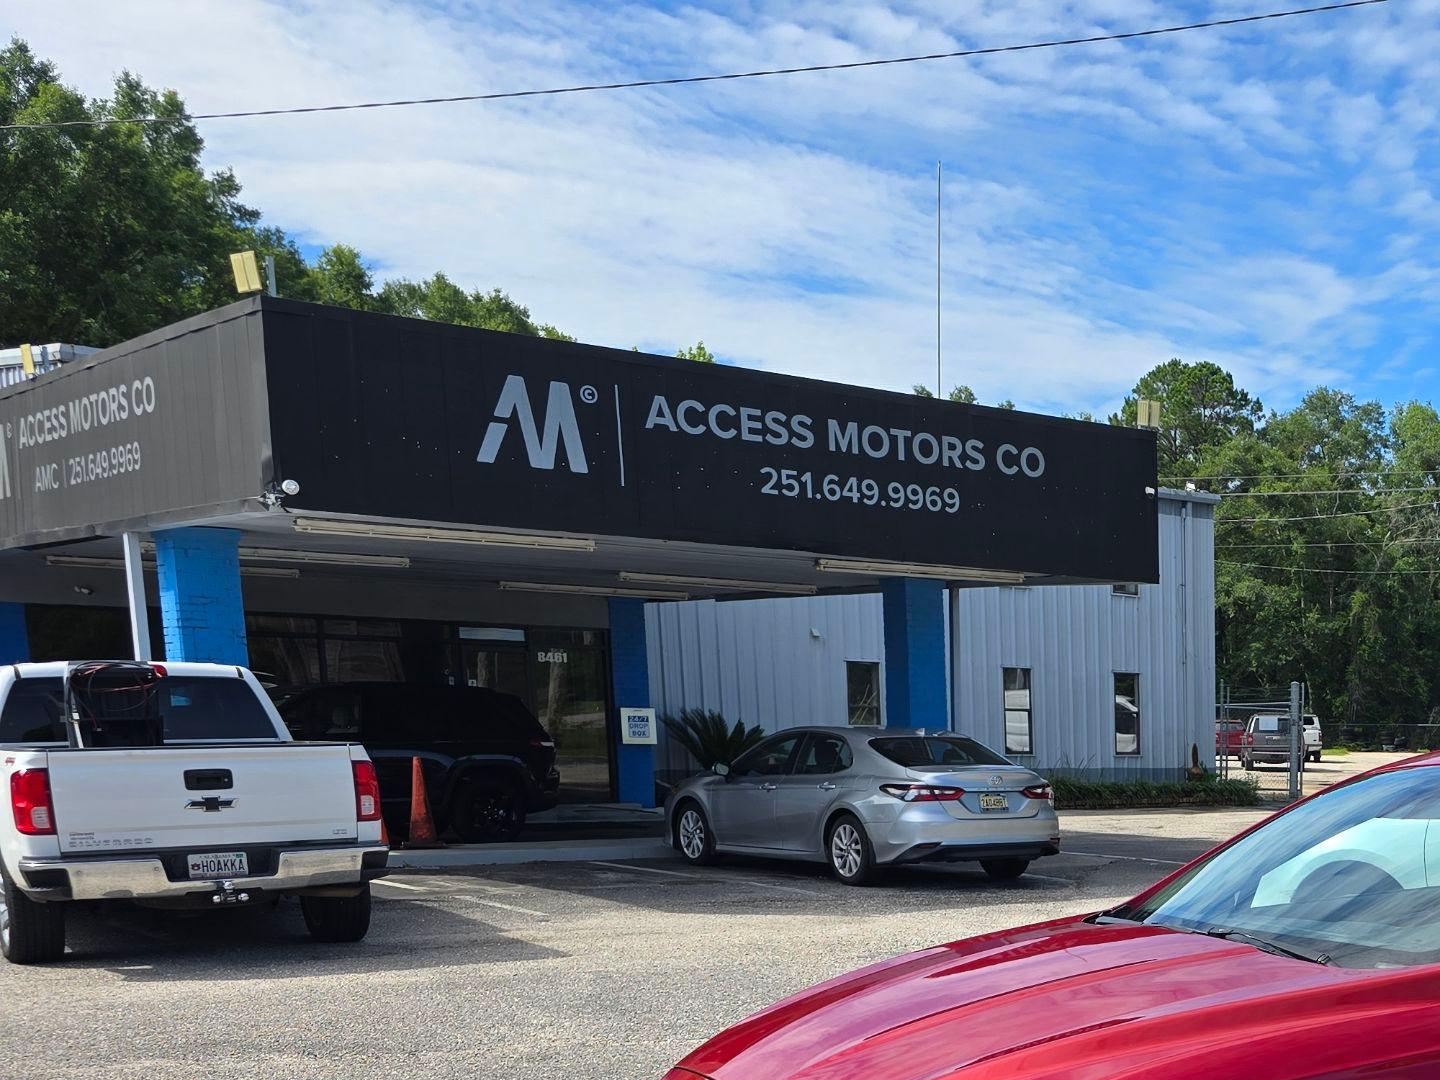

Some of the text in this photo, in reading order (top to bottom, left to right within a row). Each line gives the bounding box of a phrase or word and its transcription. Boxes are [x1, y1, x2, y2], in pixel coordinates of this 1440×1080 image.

[19, 376, 155, 449] ACCESS MOTORS CO
[645, 394, 1045, 478] ACCESS MOTORS CO
[35, 441, 141, 493] AMC 251.649.9969
[760, 466, 960, 514] 251.649.9969
[537, 651, 568, 663] 8461
[201, 859, 245, 872] HOAKKA
